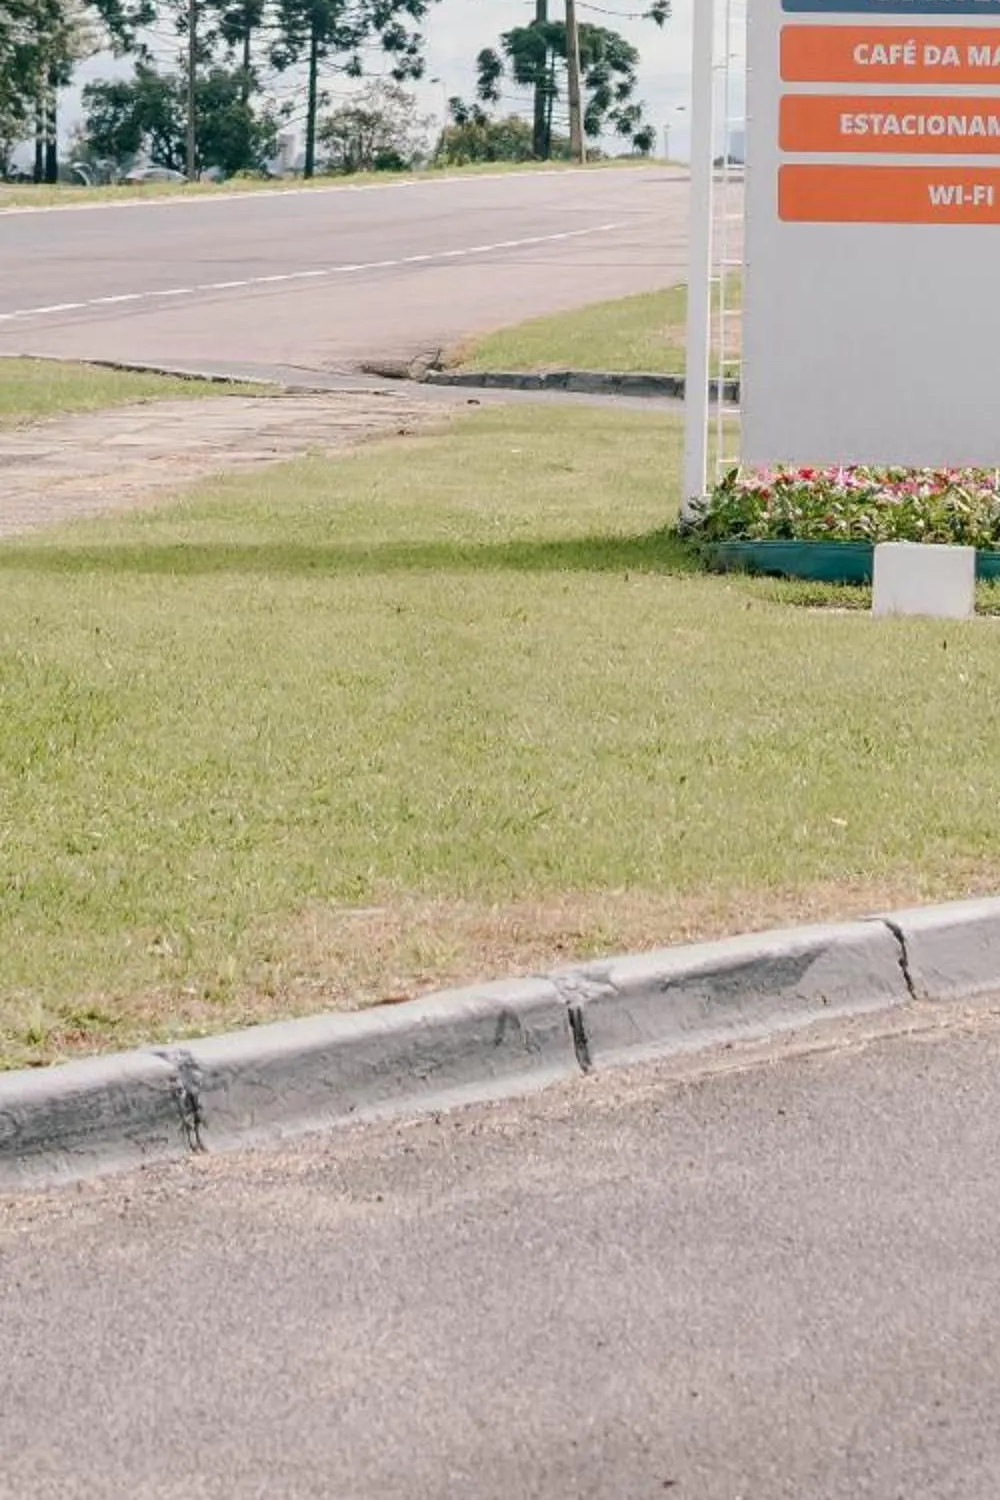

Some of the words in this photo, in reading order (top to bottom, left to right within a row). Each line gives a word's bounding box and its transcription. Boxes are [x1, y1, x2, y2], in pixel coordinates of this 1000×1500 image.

[852, 39, 918, 65] CAFÉ
[923, 45, 961, 67] DA
[927, 184, 995, 207] WI-FI
